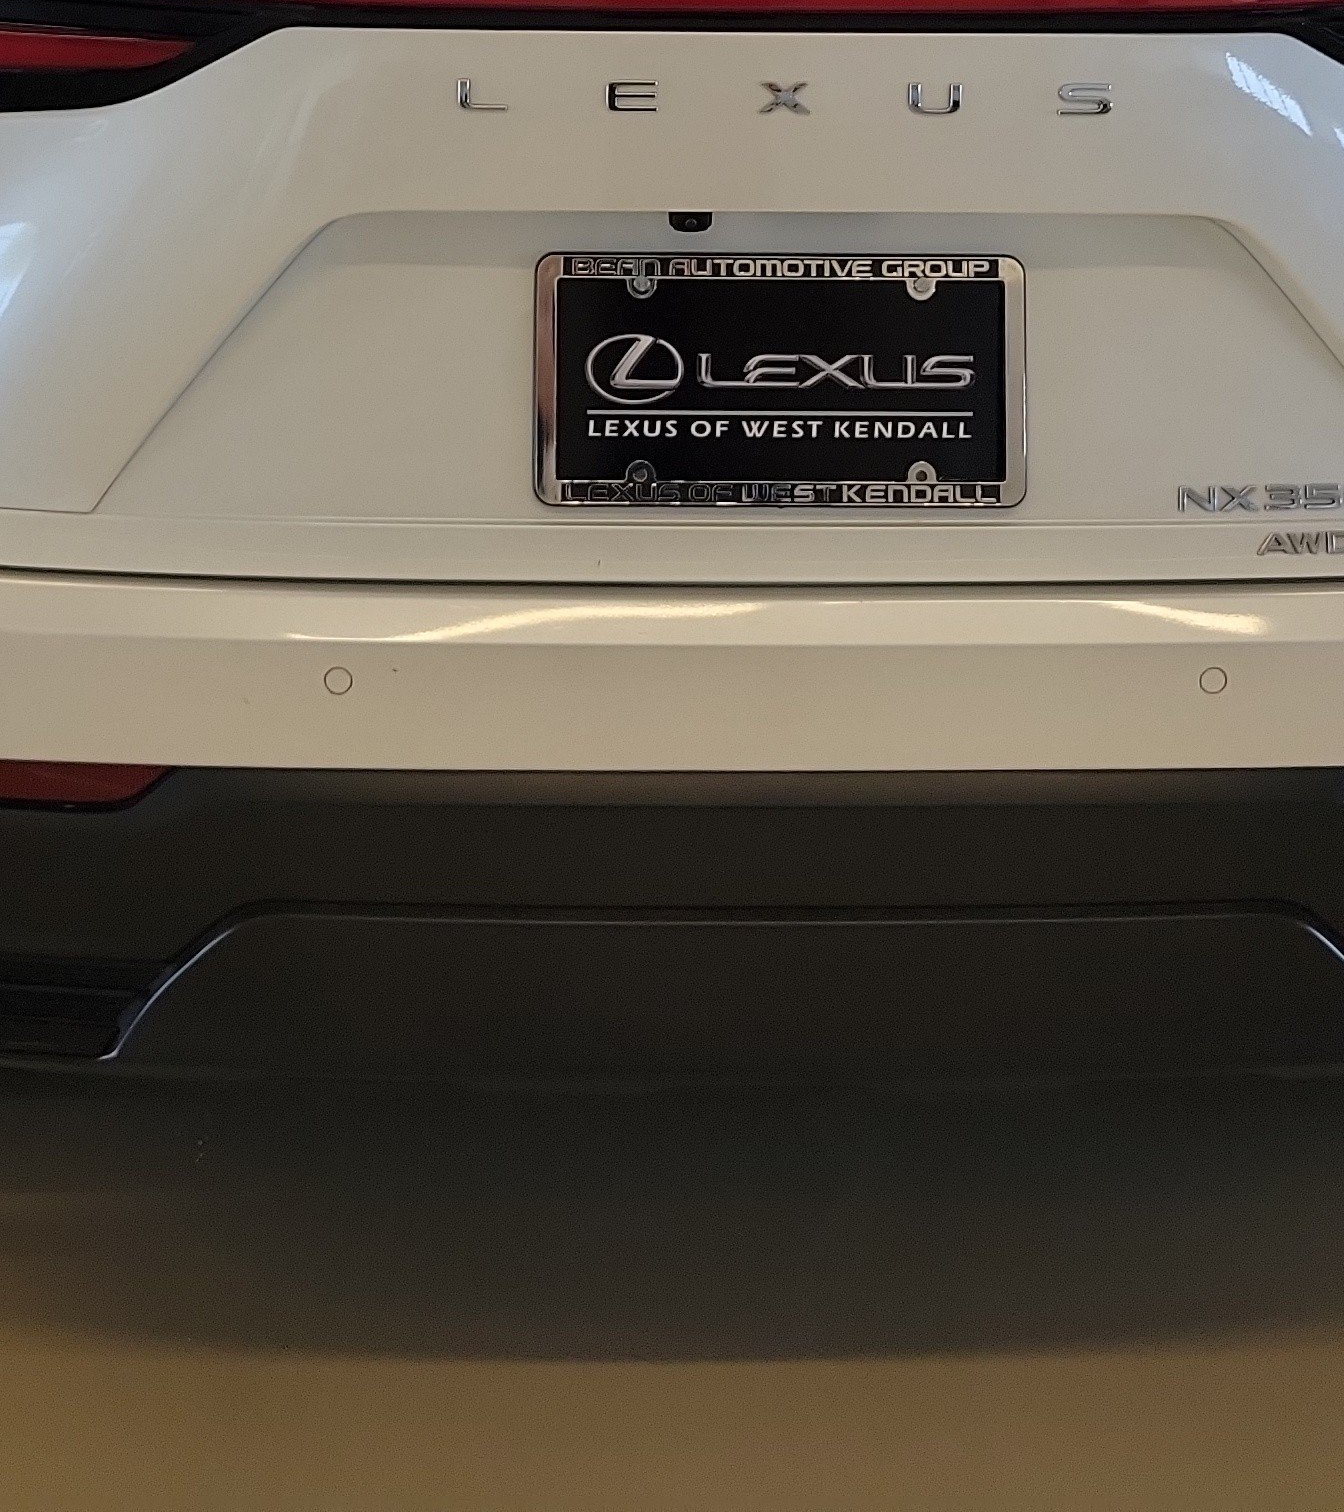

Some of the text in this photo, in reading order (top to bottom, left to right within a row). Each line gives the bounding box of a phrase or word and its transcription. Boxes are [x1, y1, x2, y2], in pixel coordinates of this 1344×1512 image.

[456, 77, 1113, 116] LEXUS
[571, 257, 991, 278] BEAN AUTOMOTIVE GROUP
[696, 353, 975, 389] LEXUS
[587, 419, 973, 440] LEXUS OF WEST KENDALL
[564, 482, 998, 504] LEXUS OF WEST KENDALL
